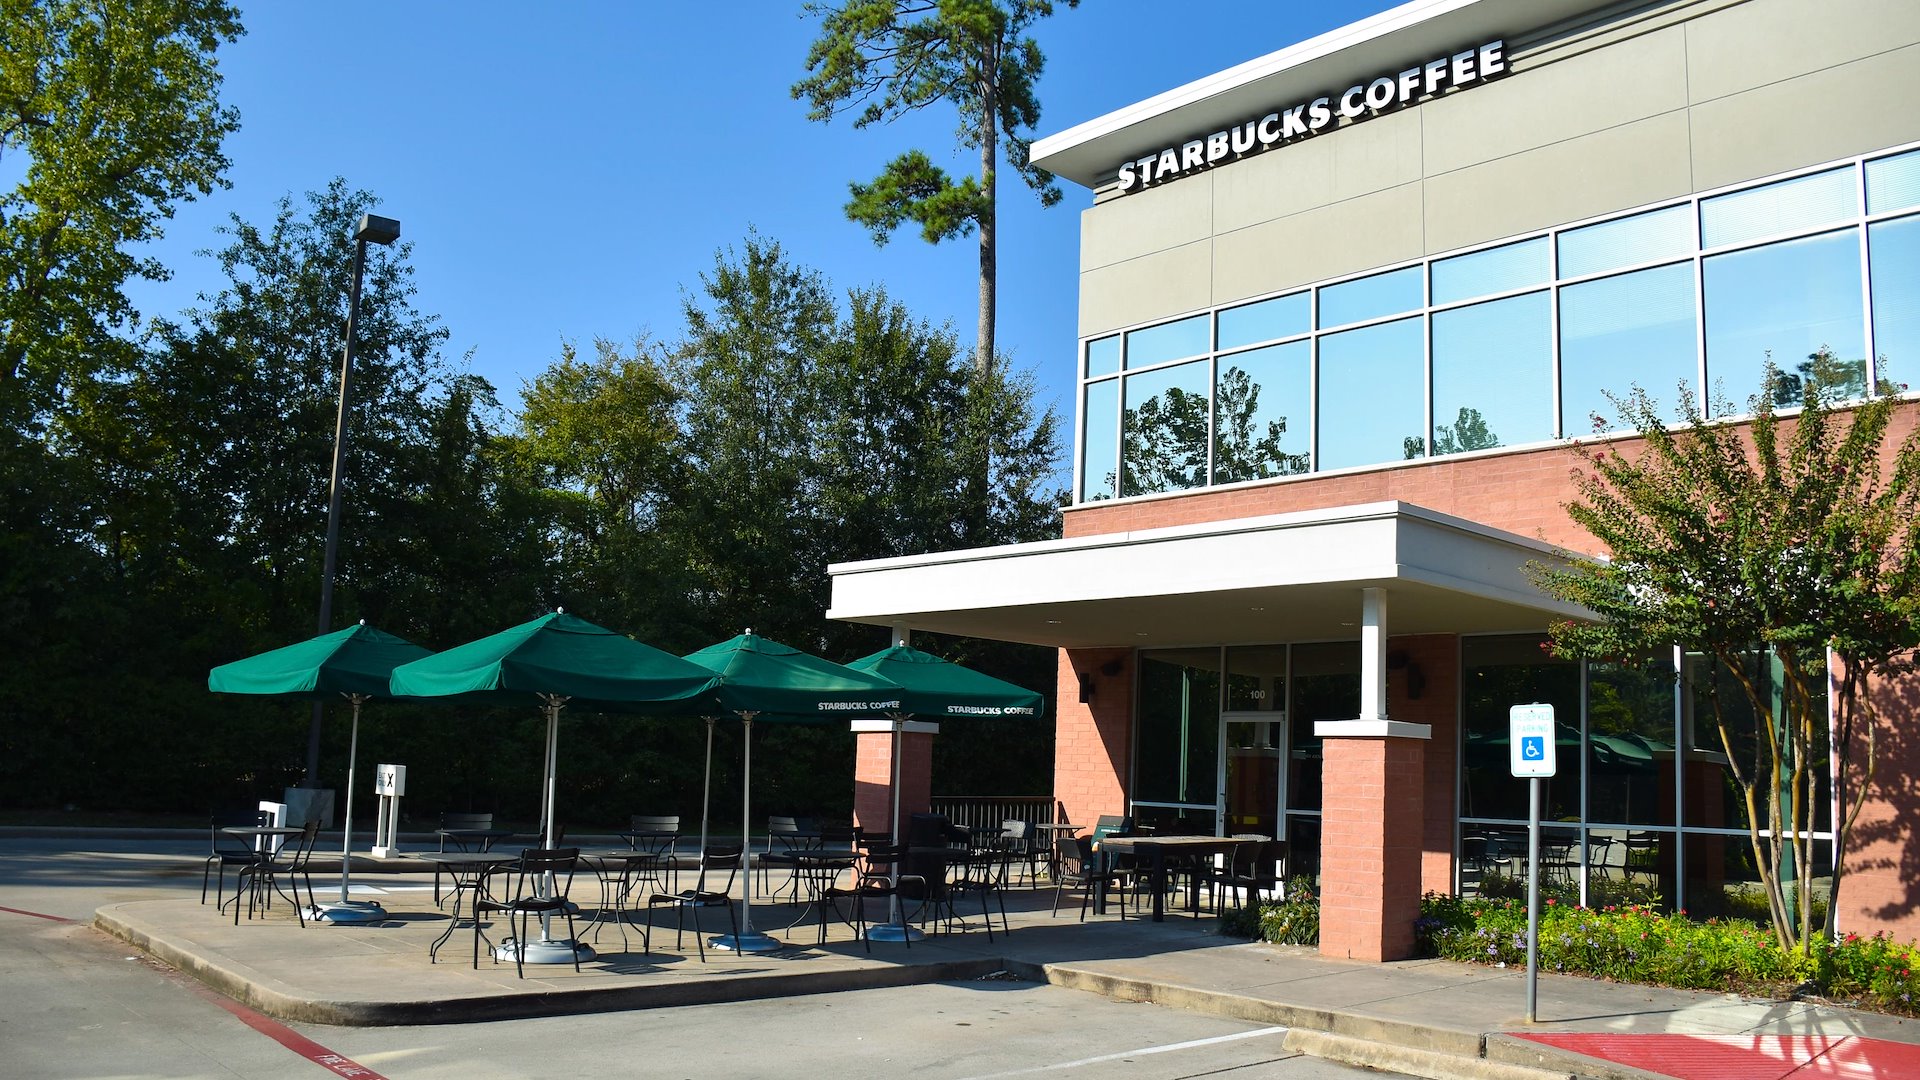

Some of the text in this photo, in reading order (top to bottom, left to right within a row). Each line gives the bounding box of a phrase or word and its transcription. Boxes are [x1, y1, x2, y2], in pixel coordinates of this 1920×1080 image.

[1117, 39, 1505, 191] STARBUCKS COFFEE
[1250, 690, 1266, 699] 100
[818, 700, 900, 711] STARBUCKS COFFEE
[947, 705, 1034, 715] STARBUCKS COFFEE
